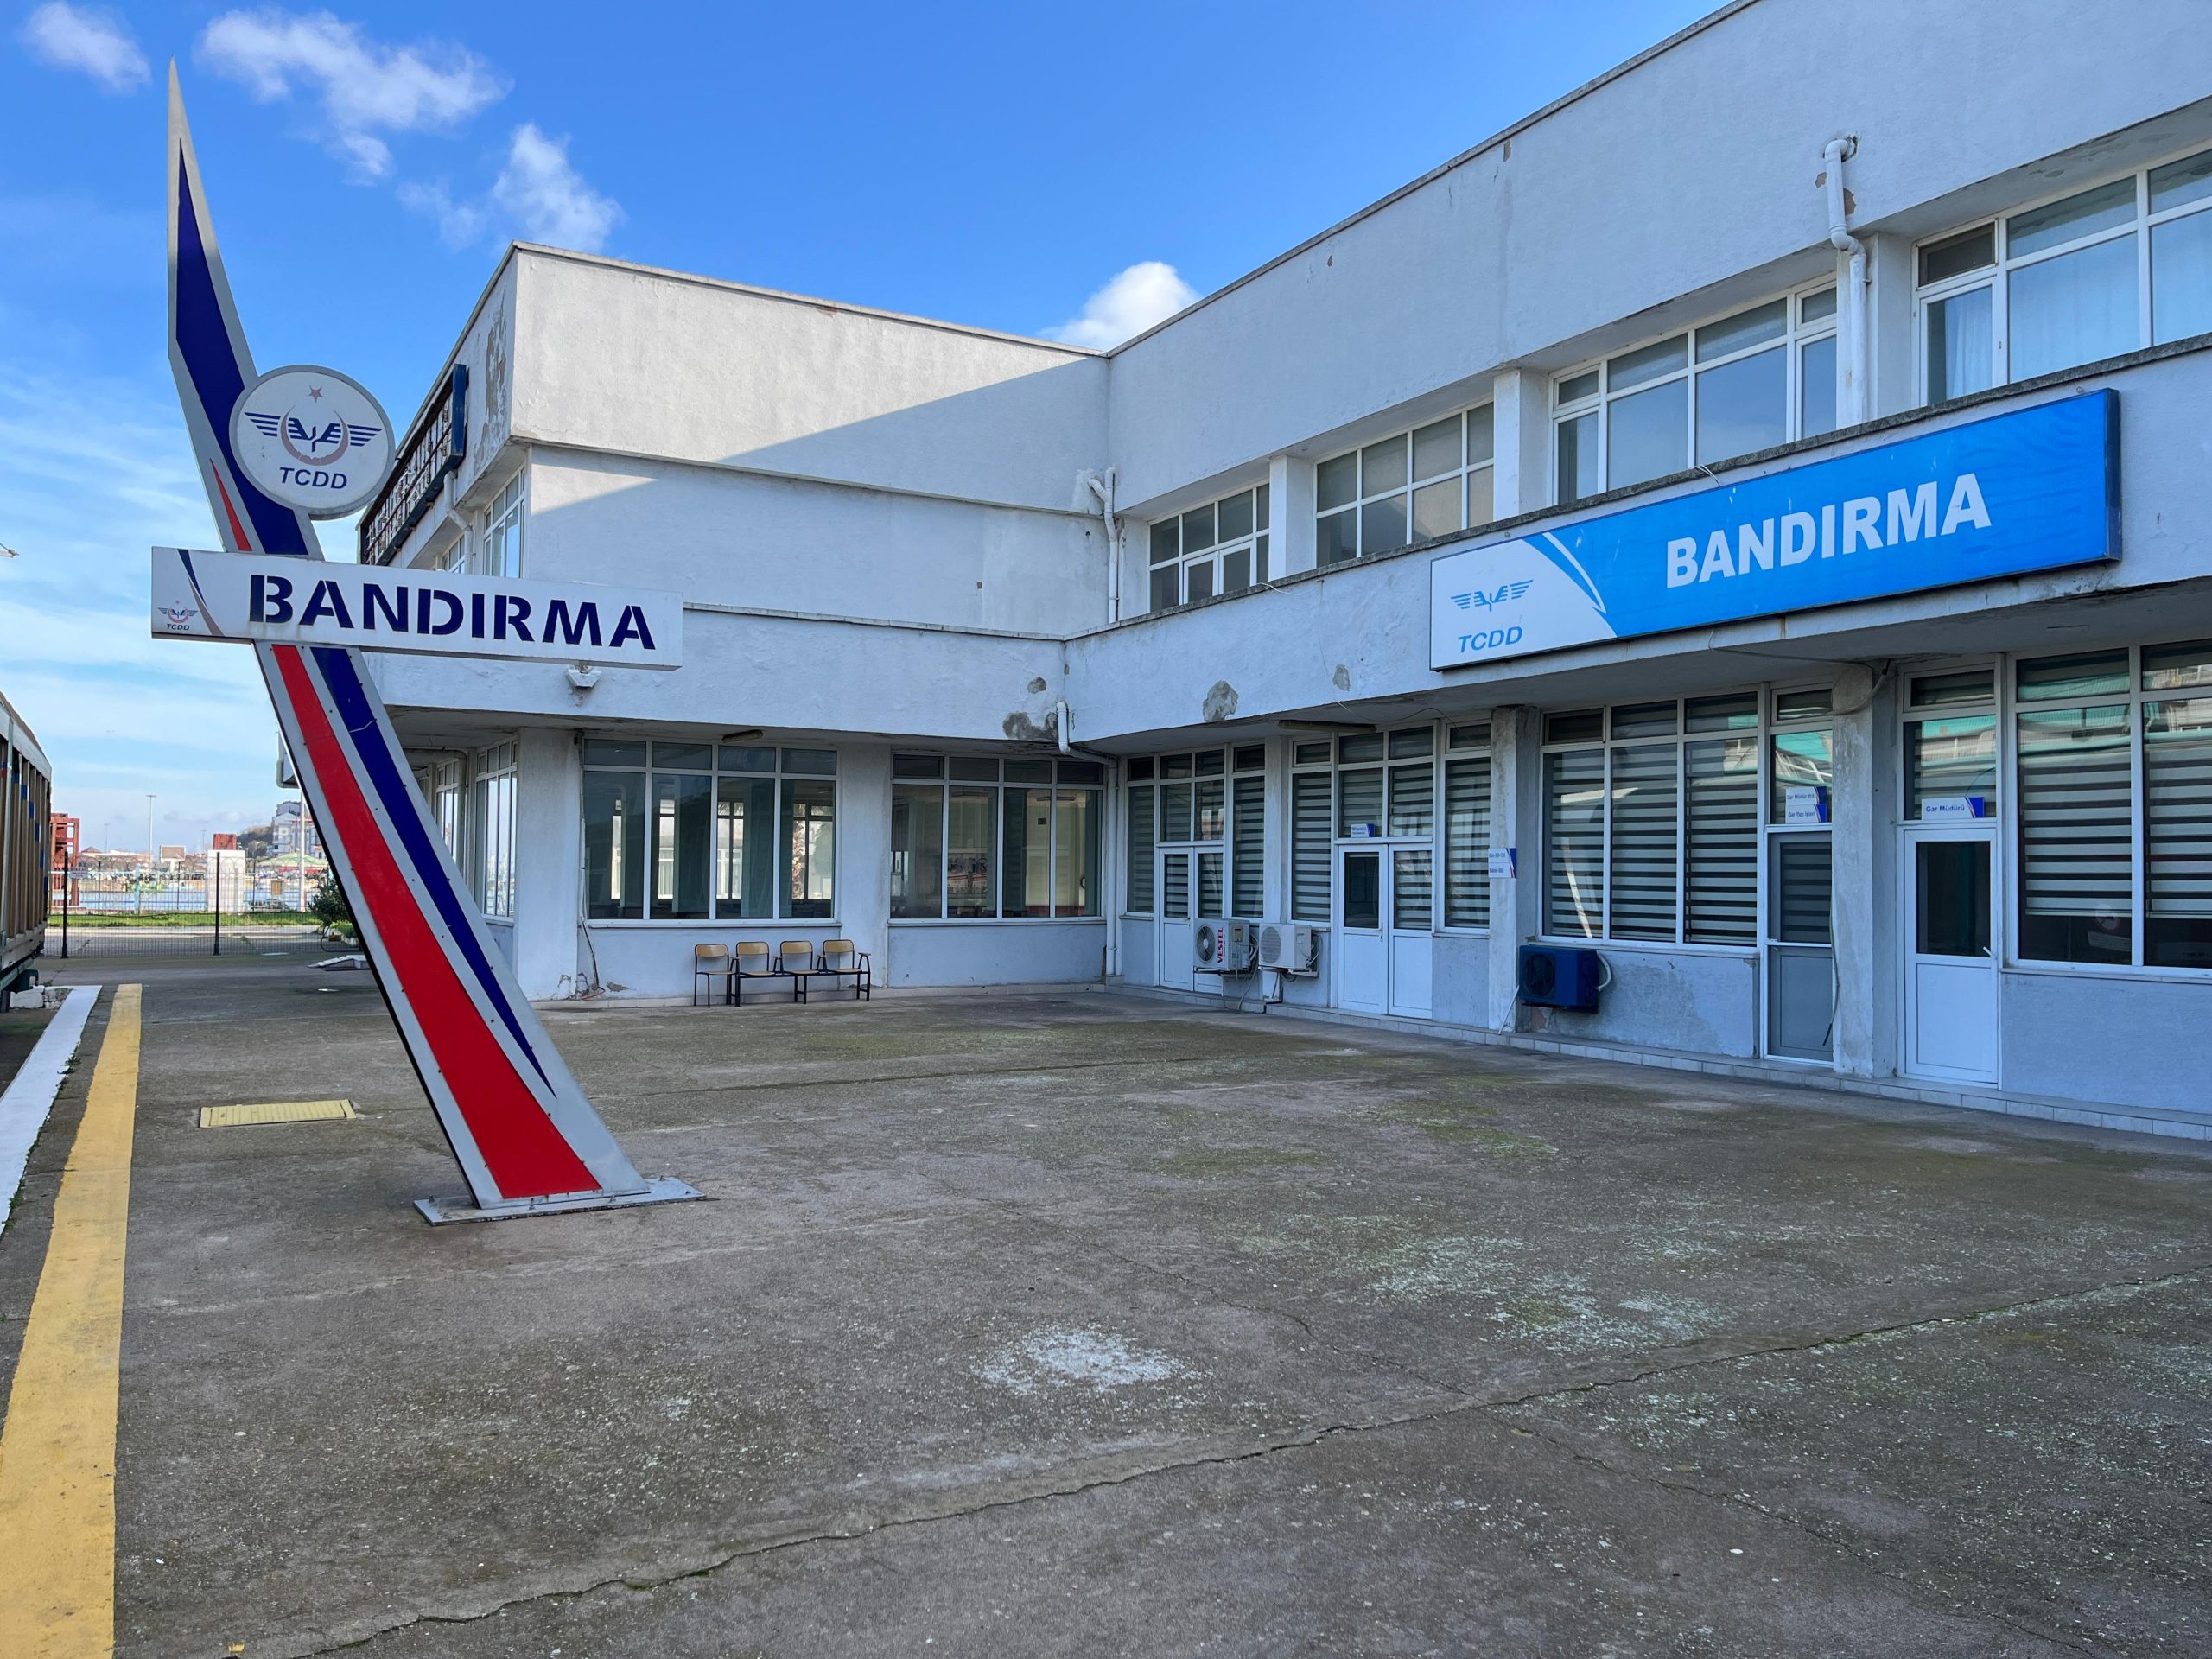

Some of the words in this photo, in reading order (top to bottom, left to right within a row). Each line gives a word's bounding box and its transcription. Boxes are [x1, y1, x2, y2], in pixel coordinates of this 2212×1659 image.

[279, 467, 347, 489] TCDD
[1666, 473, 1992, 588] BANDIRMA
[249, 574, 656, 650] BANDIRMA
[1458, 626, 1522, 653] TCDD
